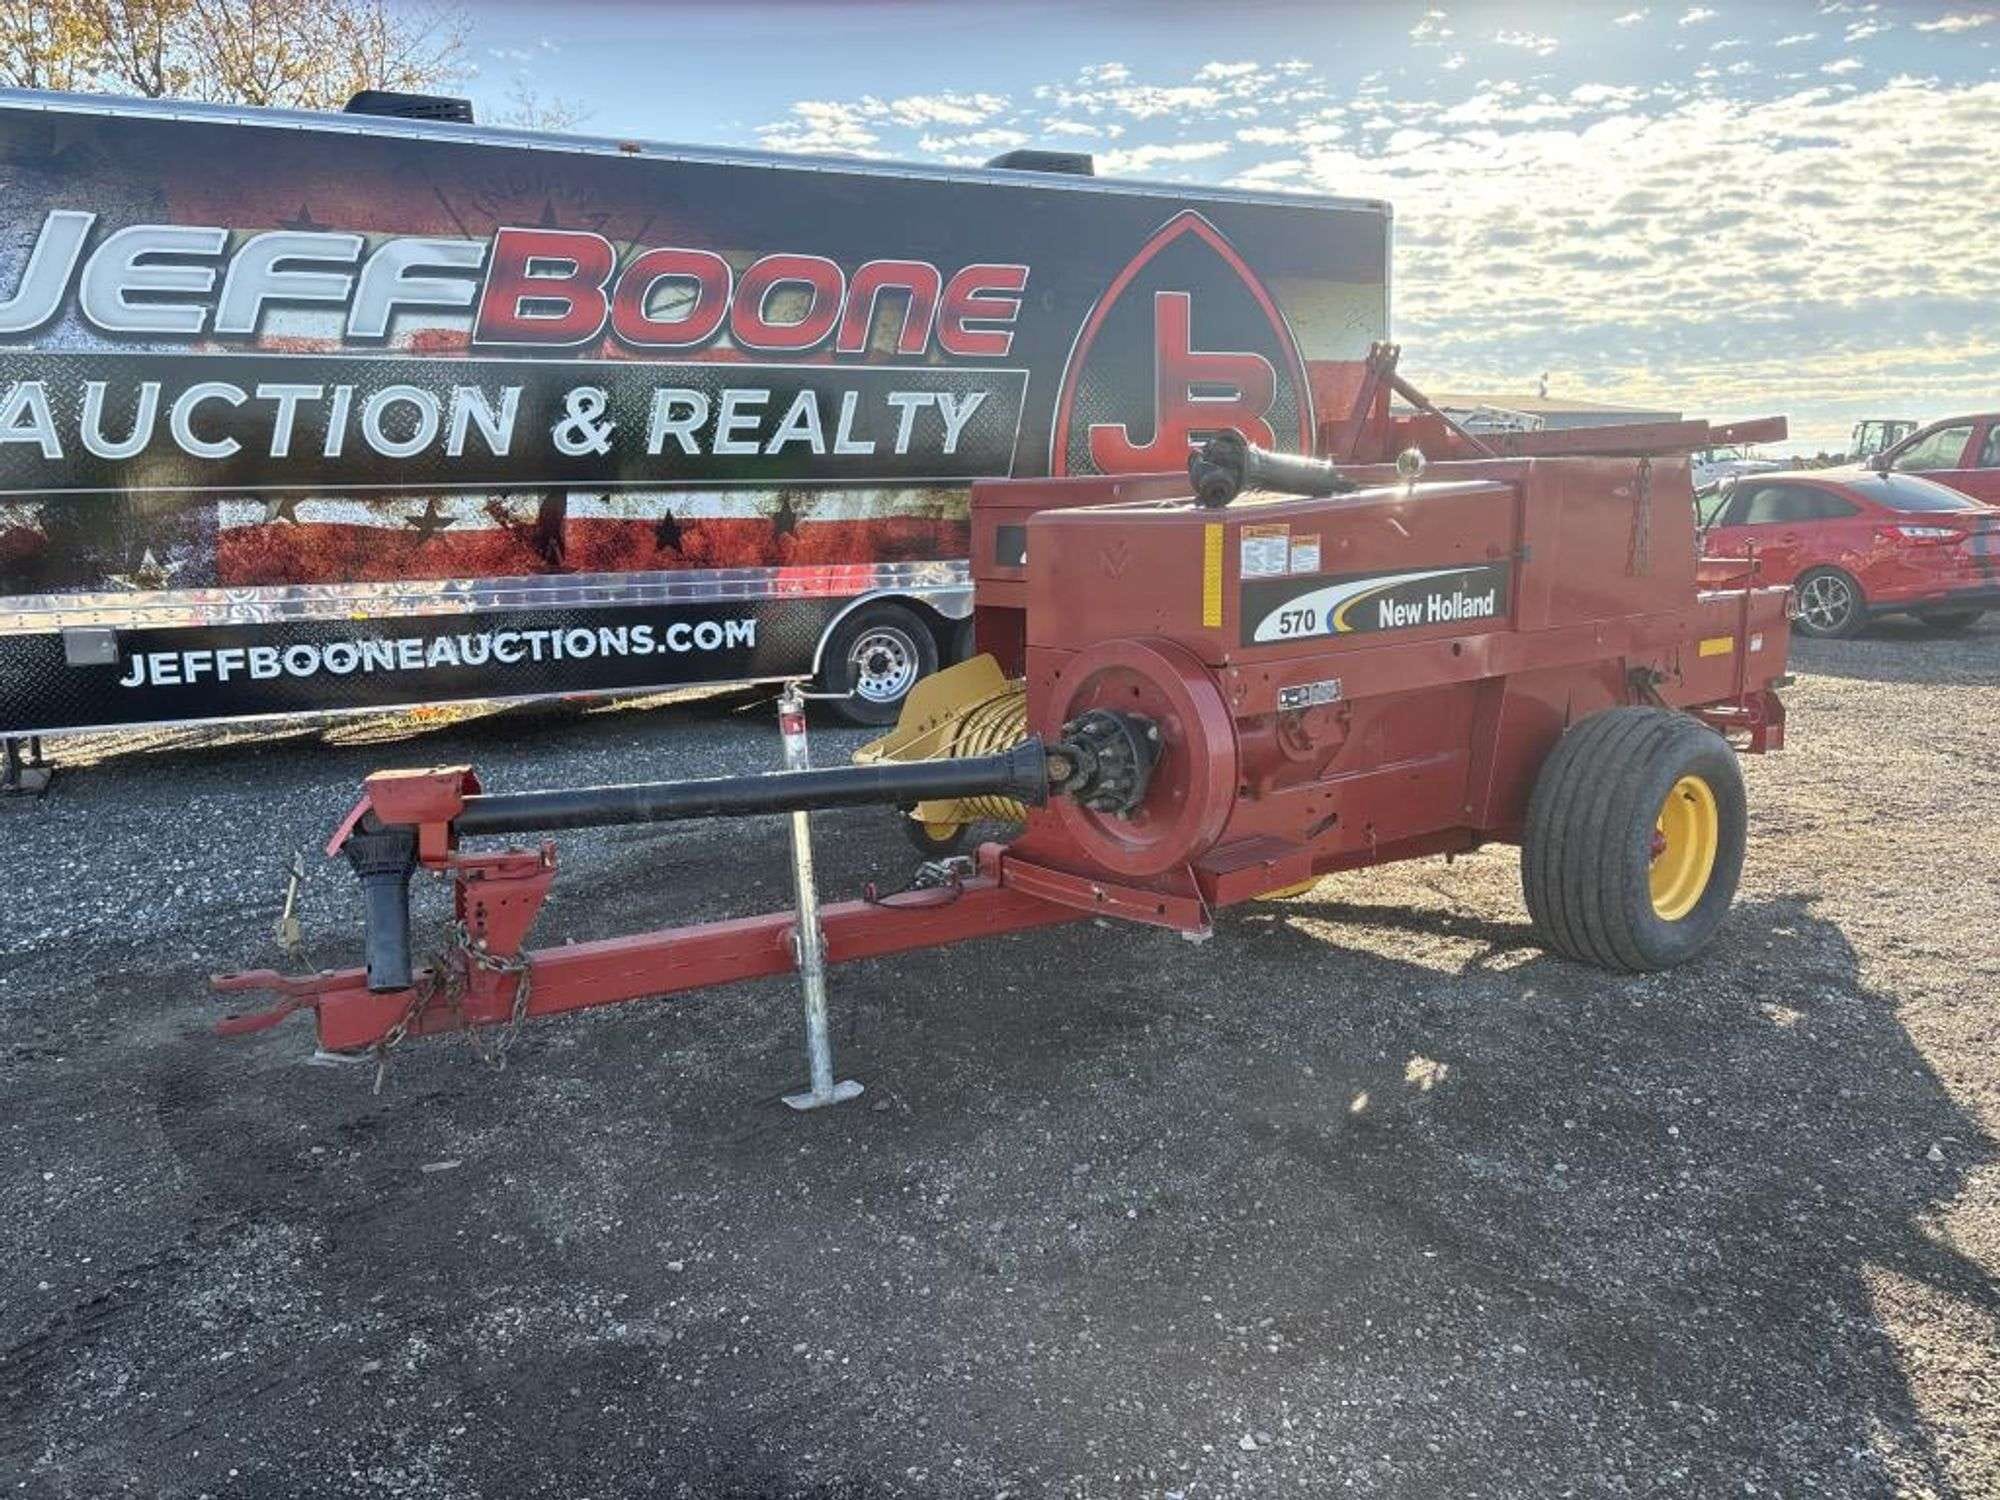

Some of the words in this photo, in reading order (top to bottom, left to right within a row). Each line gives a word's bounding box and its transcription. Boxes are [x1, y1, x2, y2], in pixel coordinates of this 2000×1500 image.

[0, 380, 522, 460] AUCTION
[552, 386, 615, 456] &
[647, 387, 989, 456] REALTY
[1279, 608, 1316, 634] 570
[1378, 597, 1422, 629] New
[1427, 589, 1495, 621] Holland
[120, 618, 758, 689] JEFFBOONEAUCTIONS.COM
